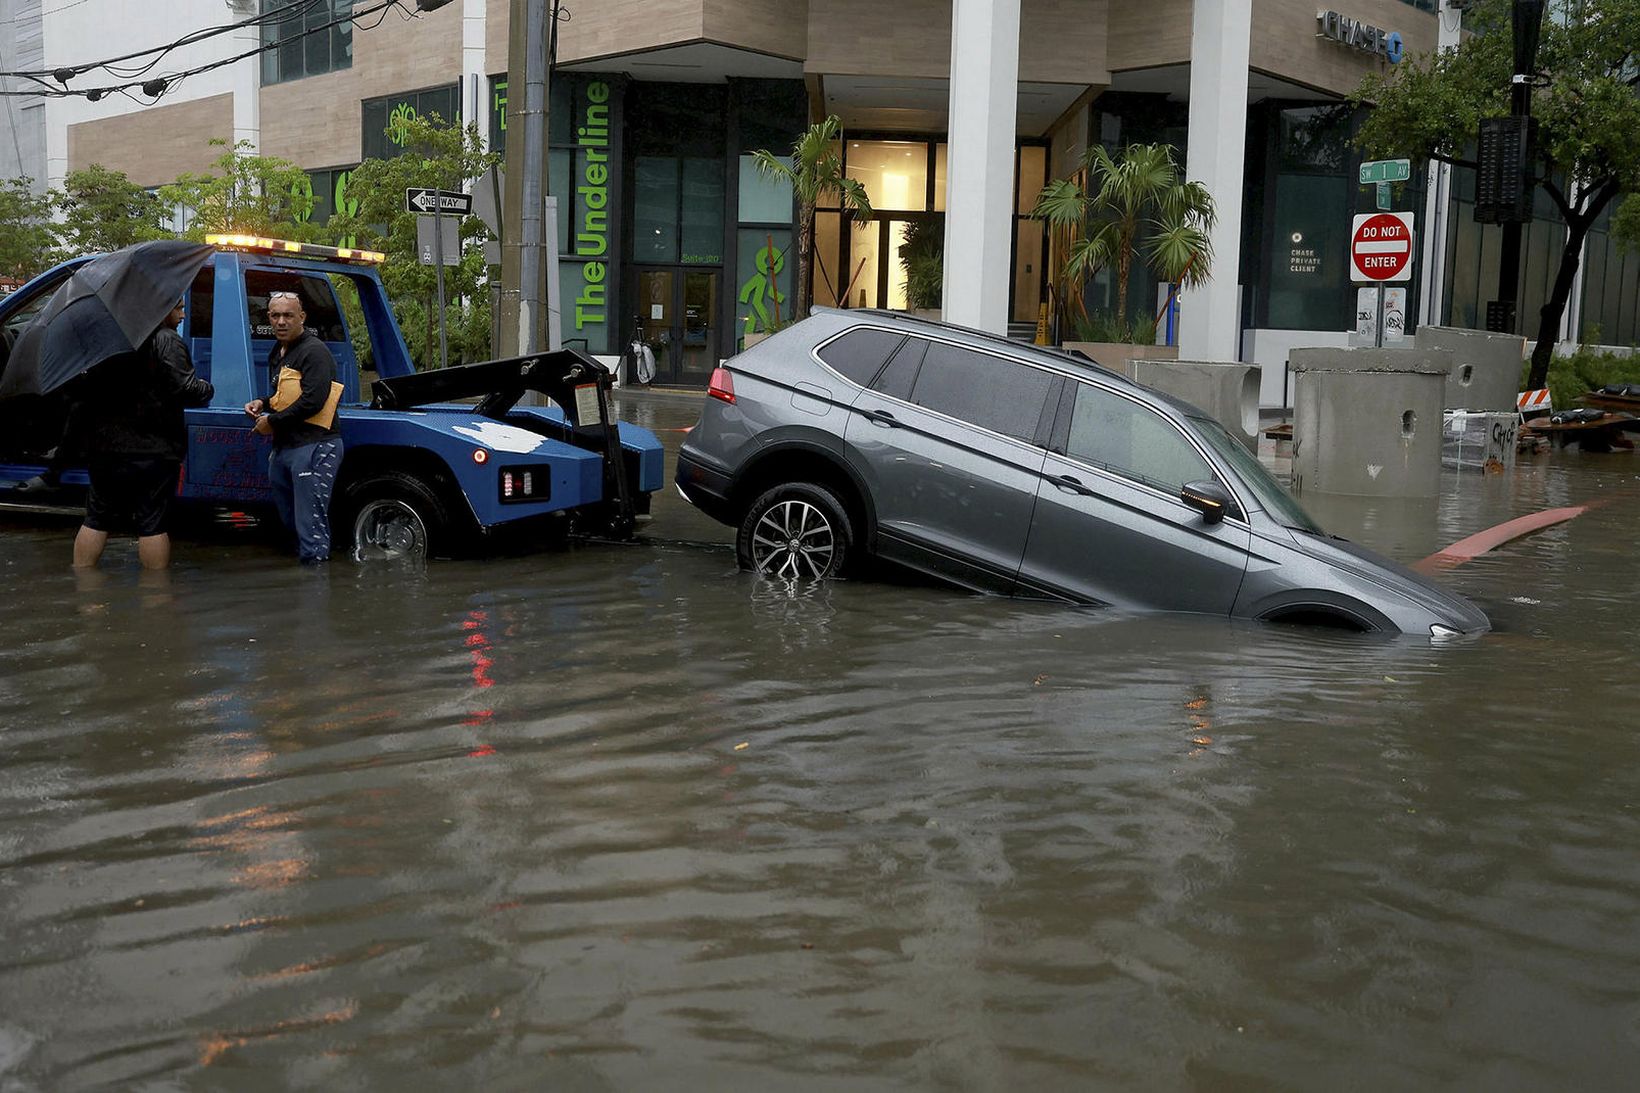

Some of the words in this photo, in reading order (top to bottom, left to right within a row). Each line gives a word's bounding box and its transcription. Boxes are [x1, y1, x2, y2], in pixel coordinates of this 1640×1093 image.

[1323, 10, 1388, 55] CHASE
[1361, 169, 1372, 180] SW
[420, 196, 436, 206] ONE
[440, 198, 459, 207] WAY
[1363, 227, 1377, 238] DO
[1381, 226, 1401, 237] NOT
[1291, 249, 1314, 257] CHASE
[1290, 257, 1321, 265] PRIVATE
[1364, 256, 1397, 268] ENTER
